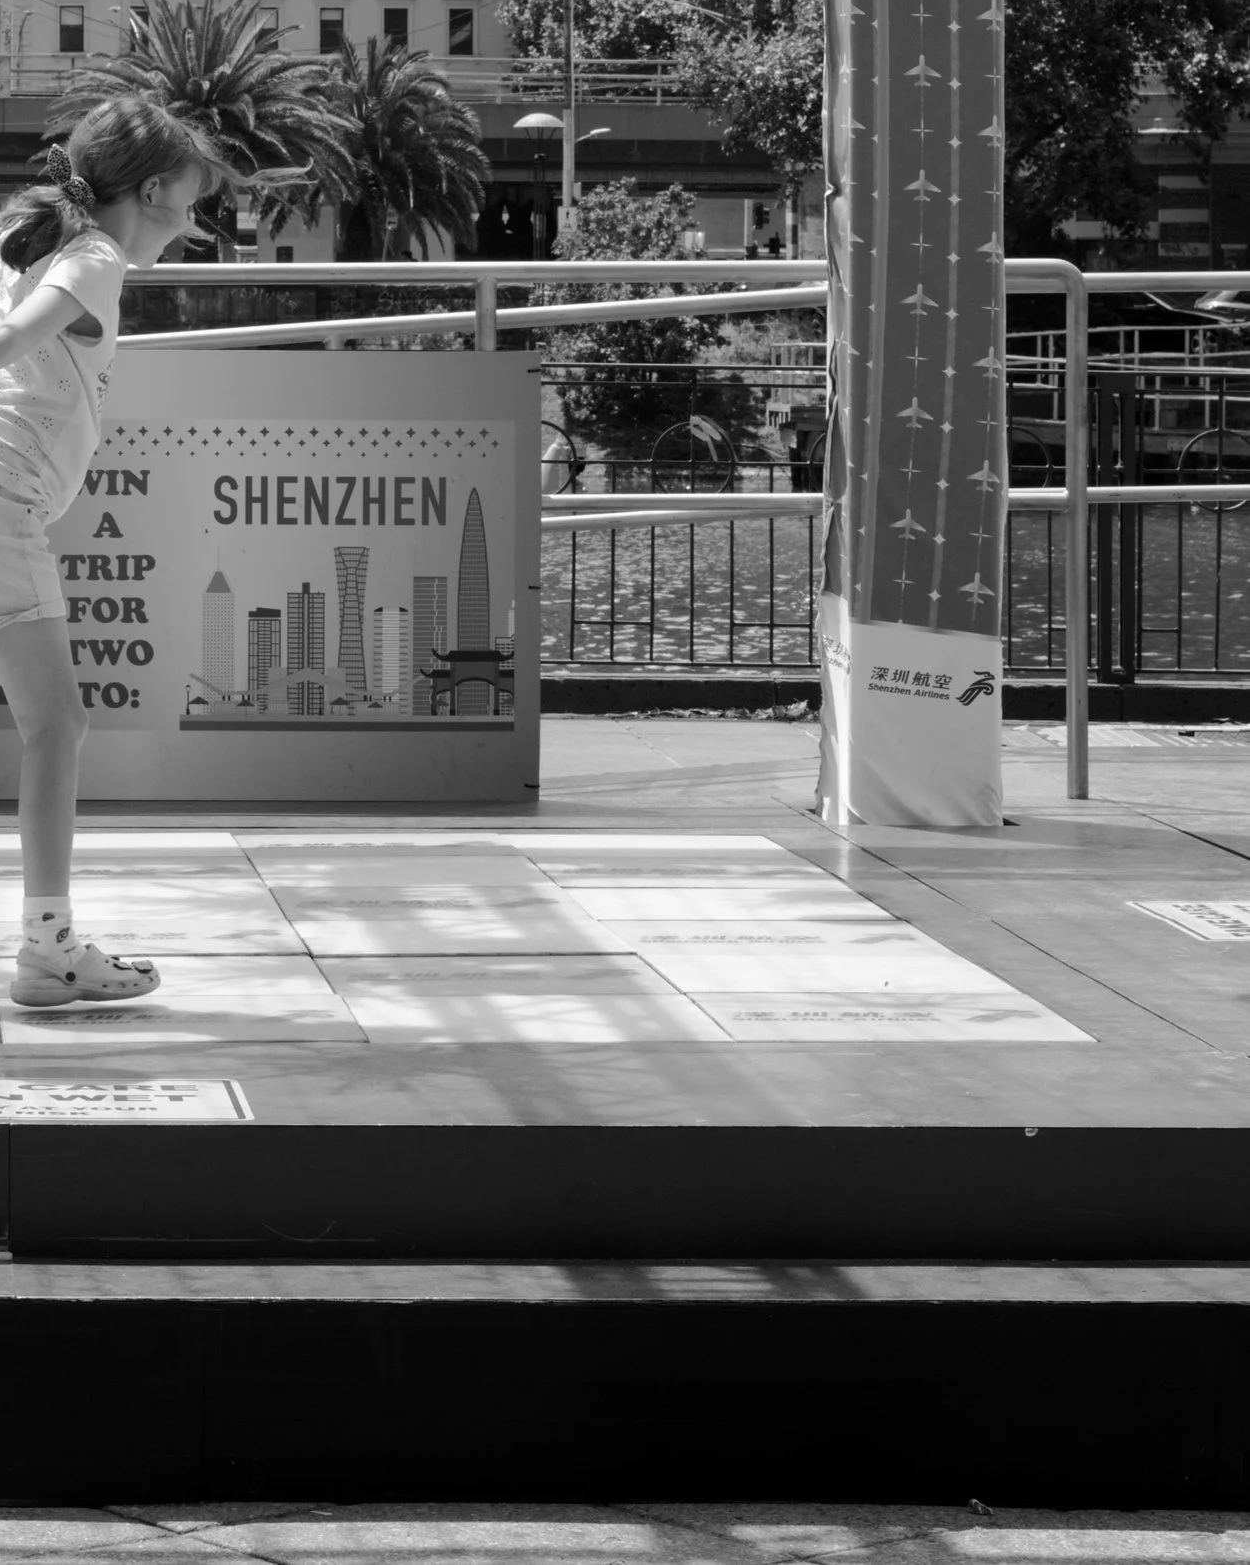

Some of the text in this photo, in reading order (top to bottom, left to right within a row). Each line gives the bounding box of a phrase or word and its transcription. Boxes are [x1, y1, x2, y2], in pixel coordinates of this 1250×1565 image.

[78, 469, 150, 496] WIN
[213, 474, 448, 526] SHENZHEN
[92, 511, 124, 538] A
[60, 554, 156, 581] TRIP
[66, 597, 149, 623] FOR
[69, 639, 154, 666] TWO
[871, 665, 953, 690] 深圳航空
[78, 682, 140, 708] TO:
[868, 683, 950, 701] Shenzhen Airlines
[16, 1084, 199, 1092] CARE
[48, 1094, 196, 1102] WET
